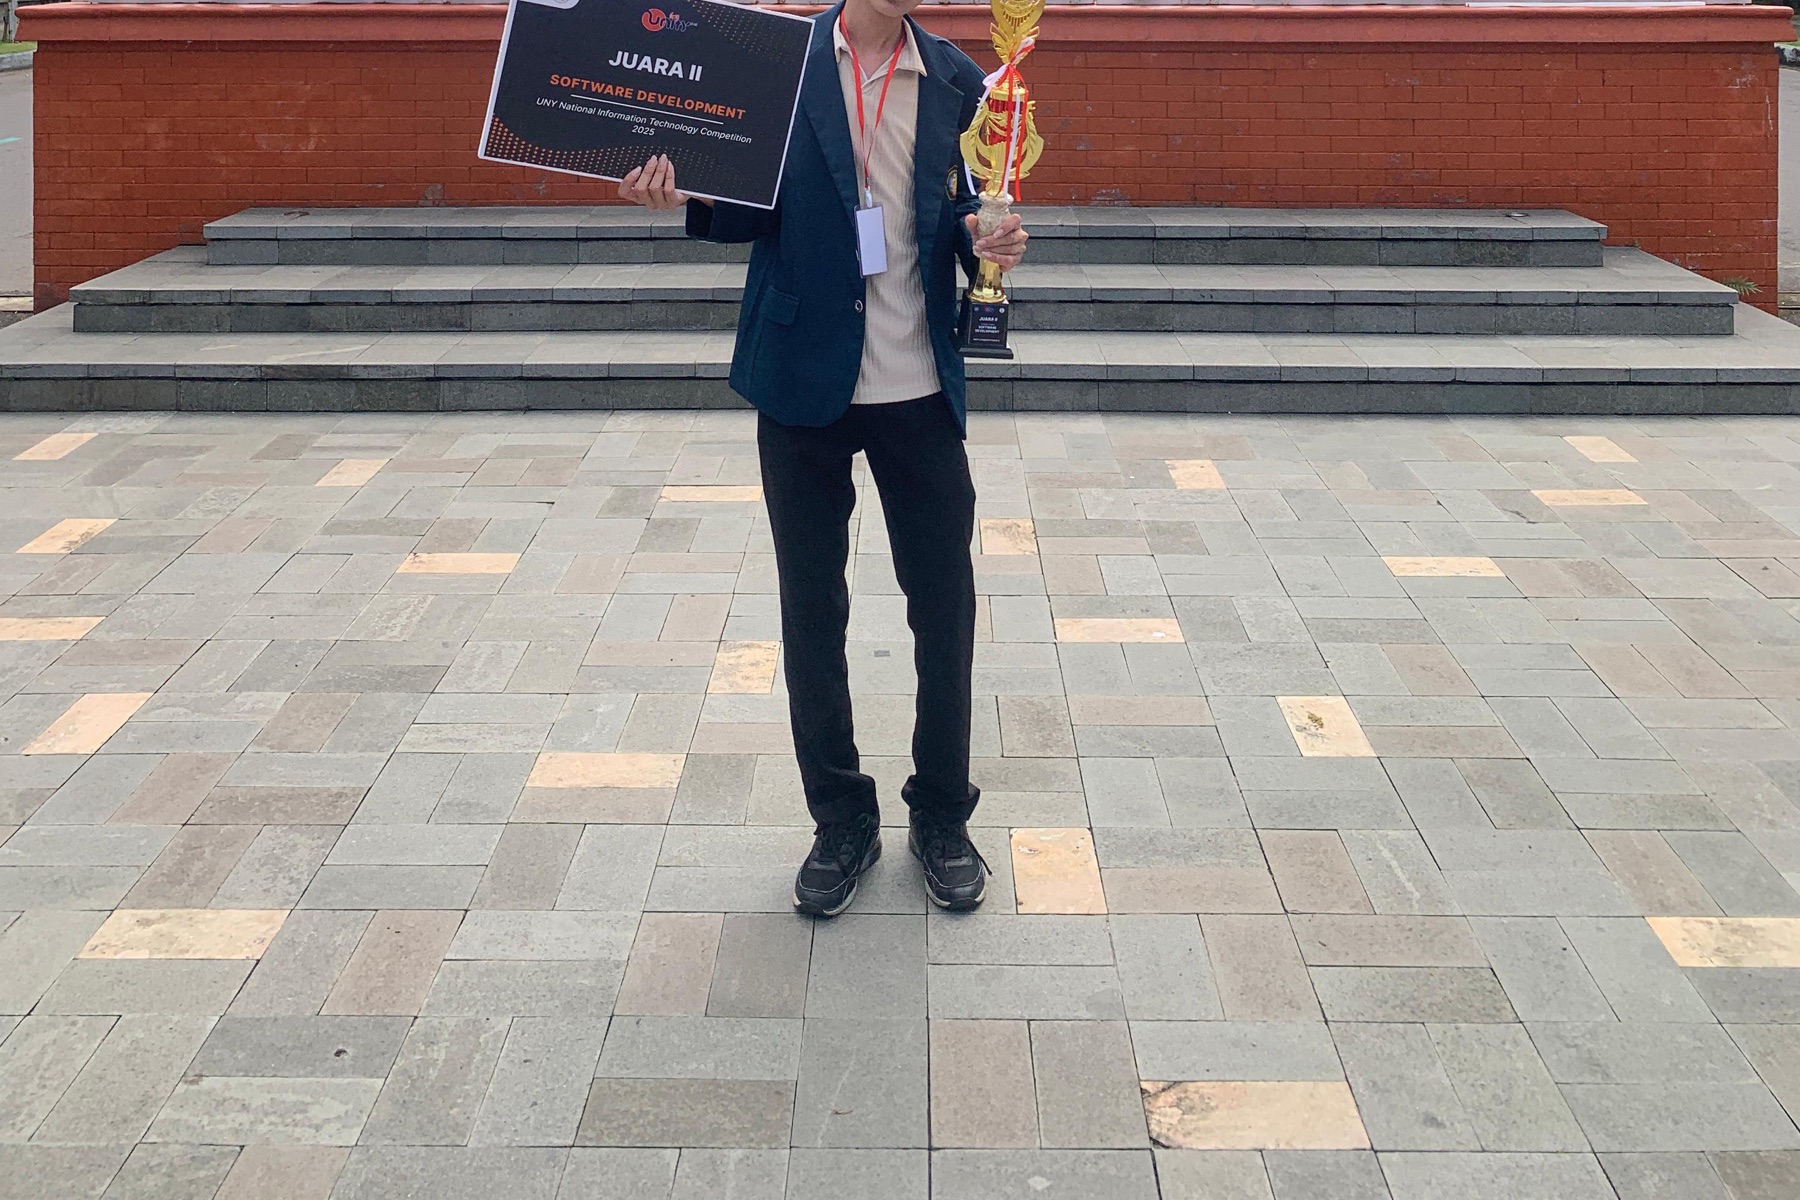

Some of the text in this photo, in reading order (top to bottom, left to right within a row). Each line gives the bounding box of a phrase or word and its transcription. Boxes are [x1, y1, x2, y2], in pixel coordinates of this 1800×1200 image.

[608, 50, 703, 82] JUARA II
[549, 74, 746, 120] SOFTWARE DEVELOPMENT
[536, 97, 752, 144] UNY National Information Technology Competition
[631, 125, 655, 136] 2025
